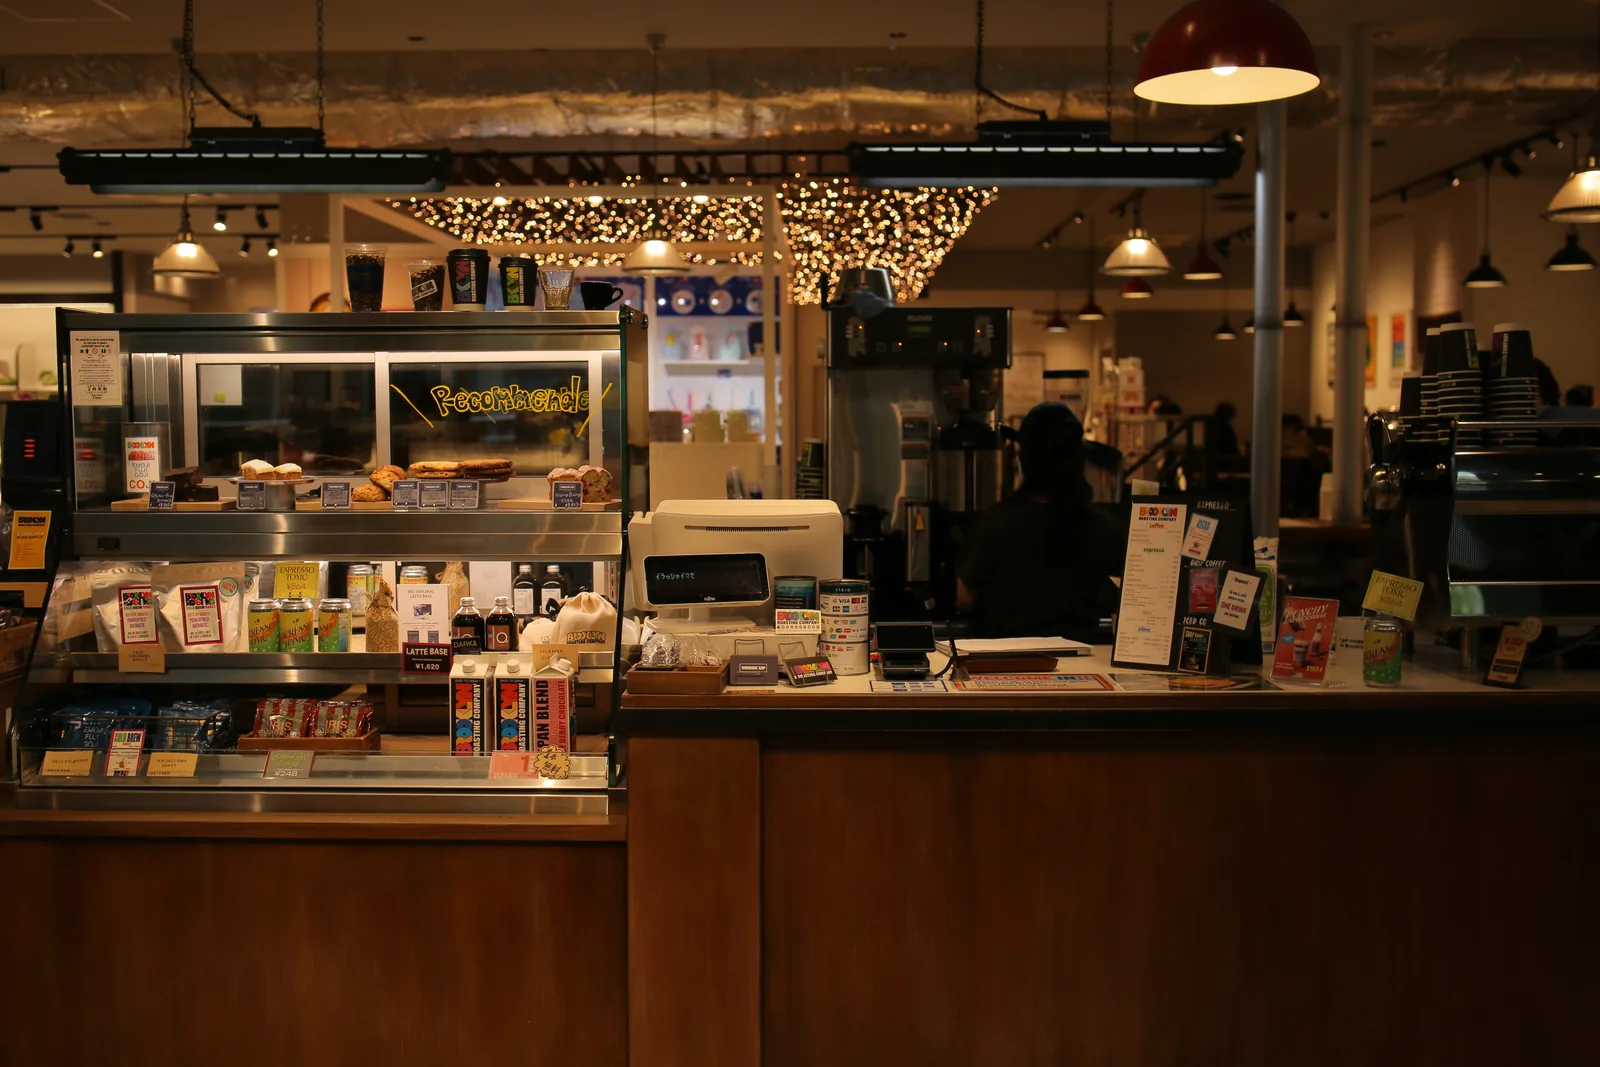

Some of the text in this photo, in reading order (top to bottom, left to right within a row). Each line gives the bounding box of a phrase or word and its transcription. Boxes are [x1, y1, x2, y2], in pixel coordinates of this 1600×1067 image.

[431, 376, 580, 416] Recommend
[1197, 501, 1230, 509] ESPRESSO
[1376, 576, 1416, 592] ESPRESSO
[1382, 586, 1407, 598] TONIC
[1285, 604, 1329, 619] PUNCHY
[1182, 617, 1197, 625] ICED
[430, 648, 448, 656] BASE
[456, 683, 473, 756] BROOKLYN
[536, 680, 550, 748] PAN BLEND
[269, 721, 292, 730] IRIS
[326, 720, 348, 729] IRIS
